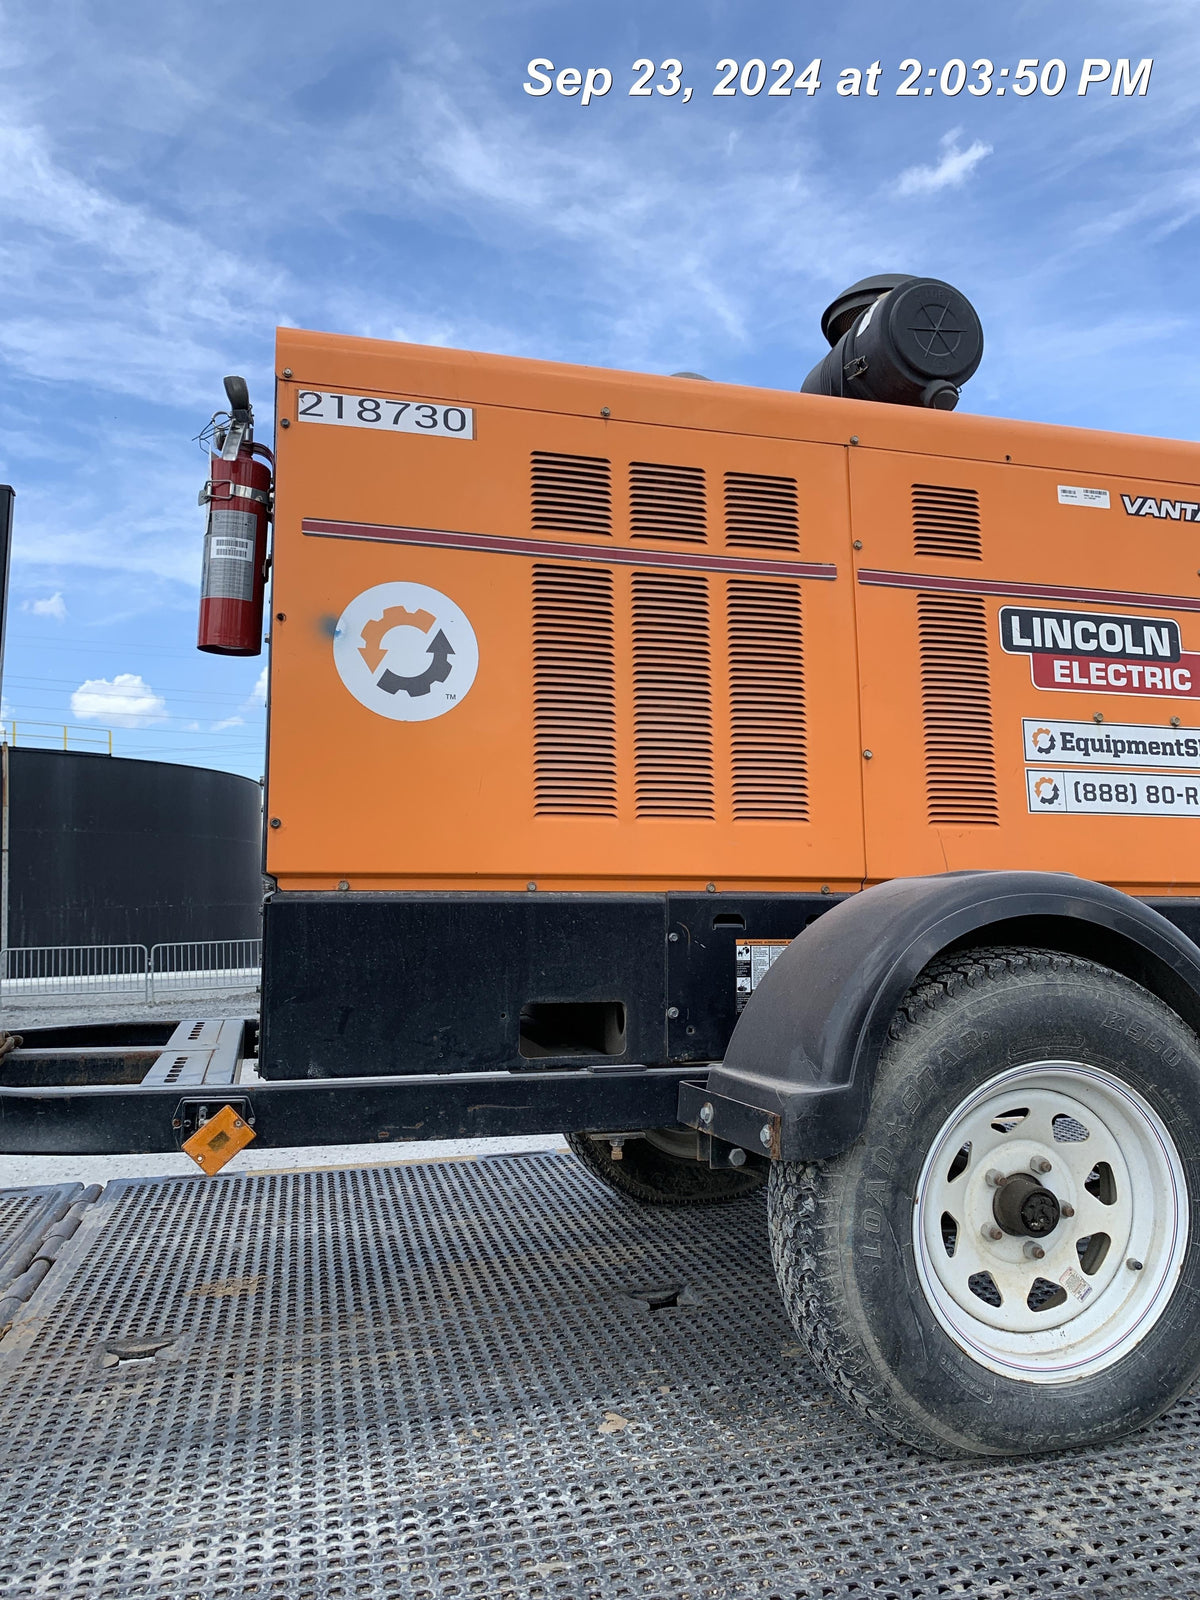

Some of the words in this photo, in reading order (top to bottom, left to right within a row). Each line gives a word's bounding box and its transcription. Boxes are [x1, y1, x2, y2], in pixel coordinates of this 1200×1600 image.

[298, 391, 467, 432] 218730
[1011, 615, 1171, 657] LINCOLN
[1053, 659, 1192, 691] ELECTRIC
[445, 693, 457, 701] TM
[1060, 731, 1200, 758] EquipmentS
[1074, 781, 1137, 804] (888)
[1100, 1009, 1182, 1068] K550
